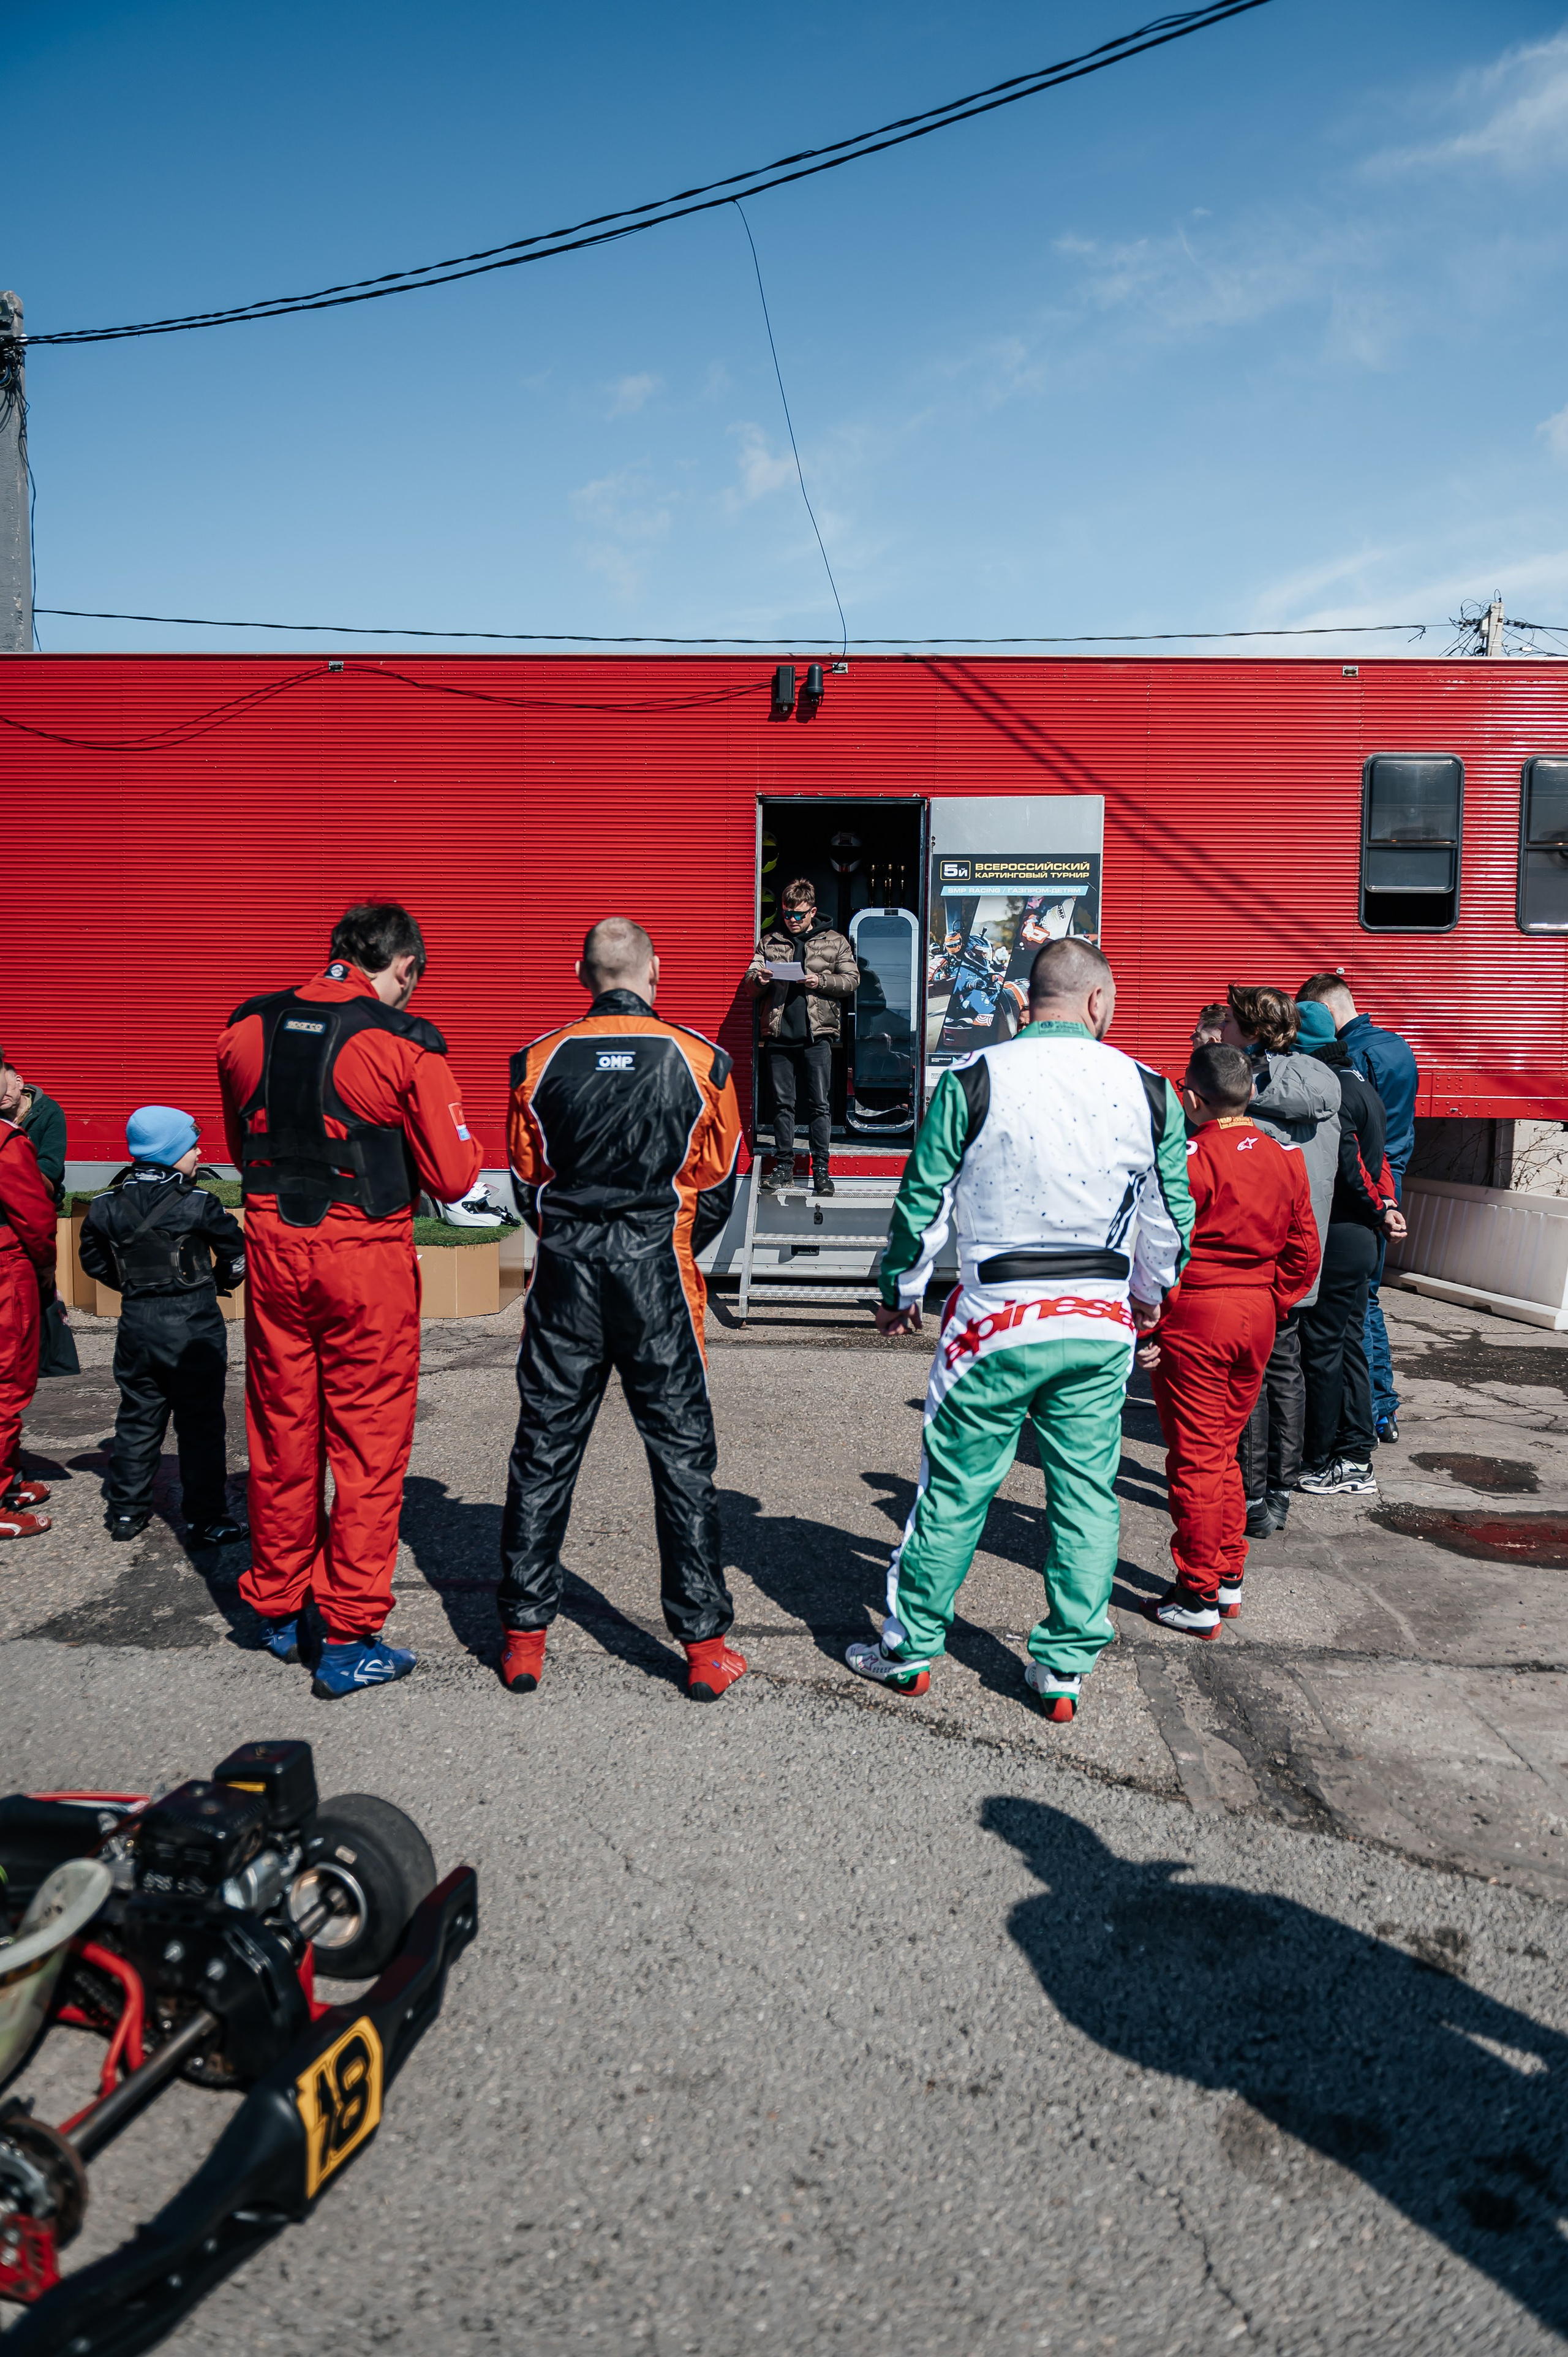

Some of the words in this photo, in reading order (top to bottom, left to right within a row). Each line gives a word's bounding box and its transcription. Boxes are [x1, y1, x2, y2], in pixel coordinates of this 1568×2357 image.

[943, 864, 968, 877] 5й
[975, 861, 1090, 871] ВСЕРОССИЙСКИЙ
[599, 1055, 633, 1068] OMP
